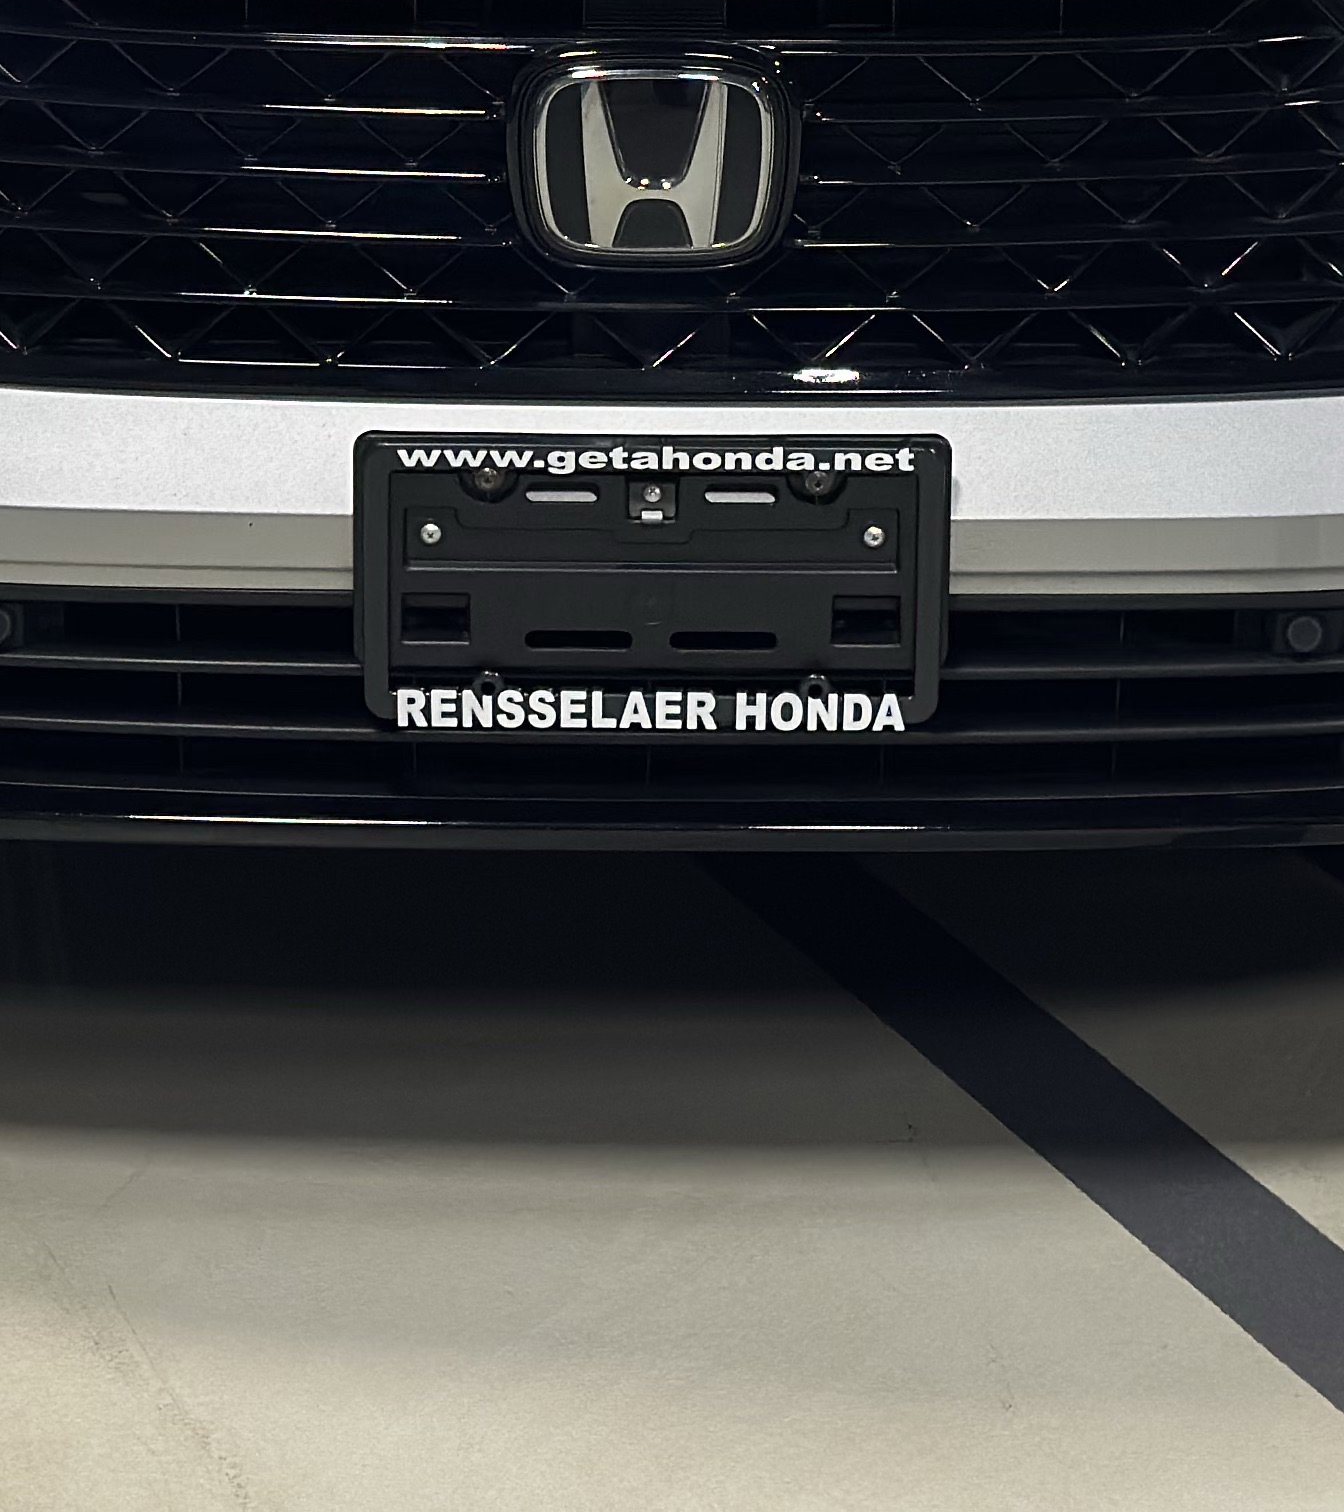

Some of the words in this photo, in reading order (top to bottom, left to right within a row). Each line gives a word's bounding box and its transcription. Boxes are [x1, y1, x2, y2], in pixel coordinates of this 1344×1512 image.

[397, 446, 915, 475] www.getahonda.net
[396, 689, 717, 729] RENSSELAER
[734, 692, 906, 732] HONDA
